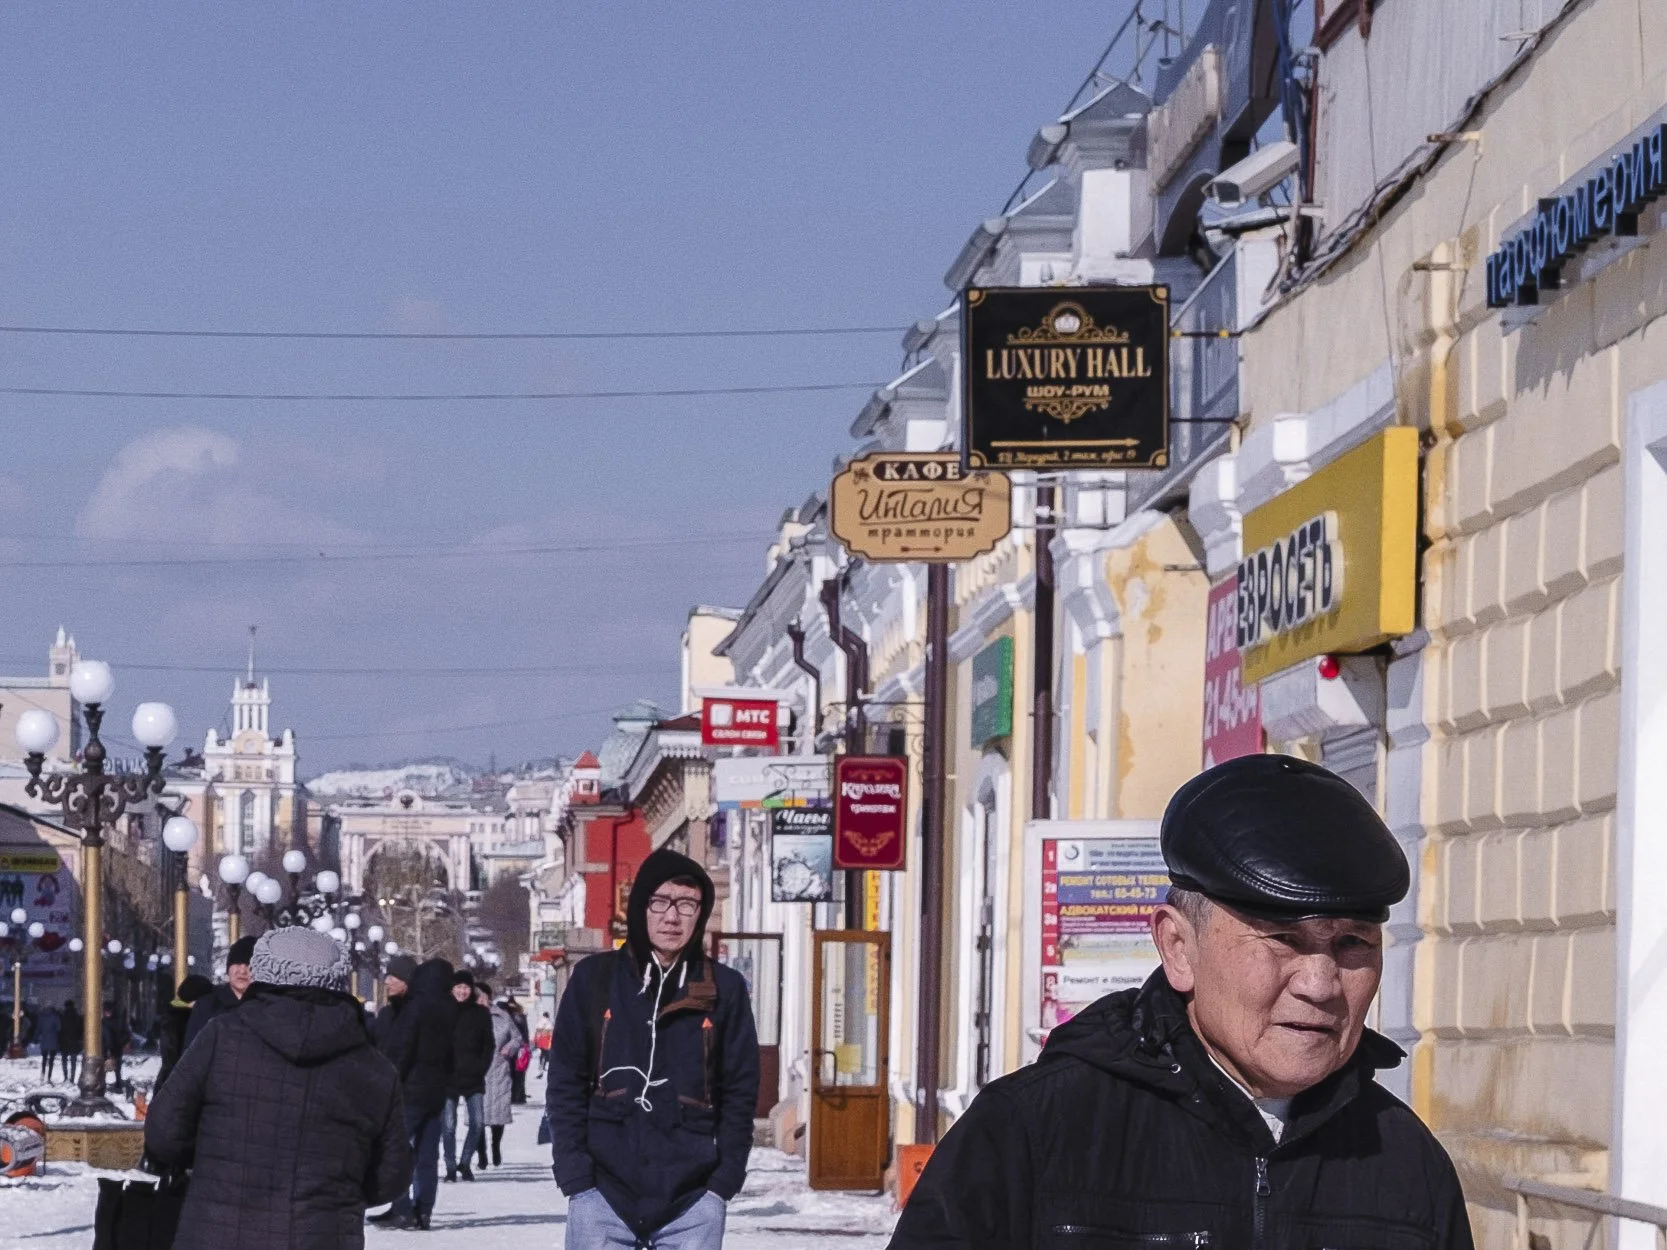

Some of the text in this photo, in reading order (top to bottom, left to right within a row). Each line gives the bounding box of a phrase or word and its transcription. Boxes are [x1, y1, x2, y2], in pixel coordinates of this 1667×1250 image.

[985, 347, 1152, 379] LUXURY HALL
[883, 462, 960, 480] КАФЕ
[867, 527, 975, 544] траттория
[1236, 511, 1340, 648] ЕВРОСЕТЬ
[735, 709, 770, 724] МТС
